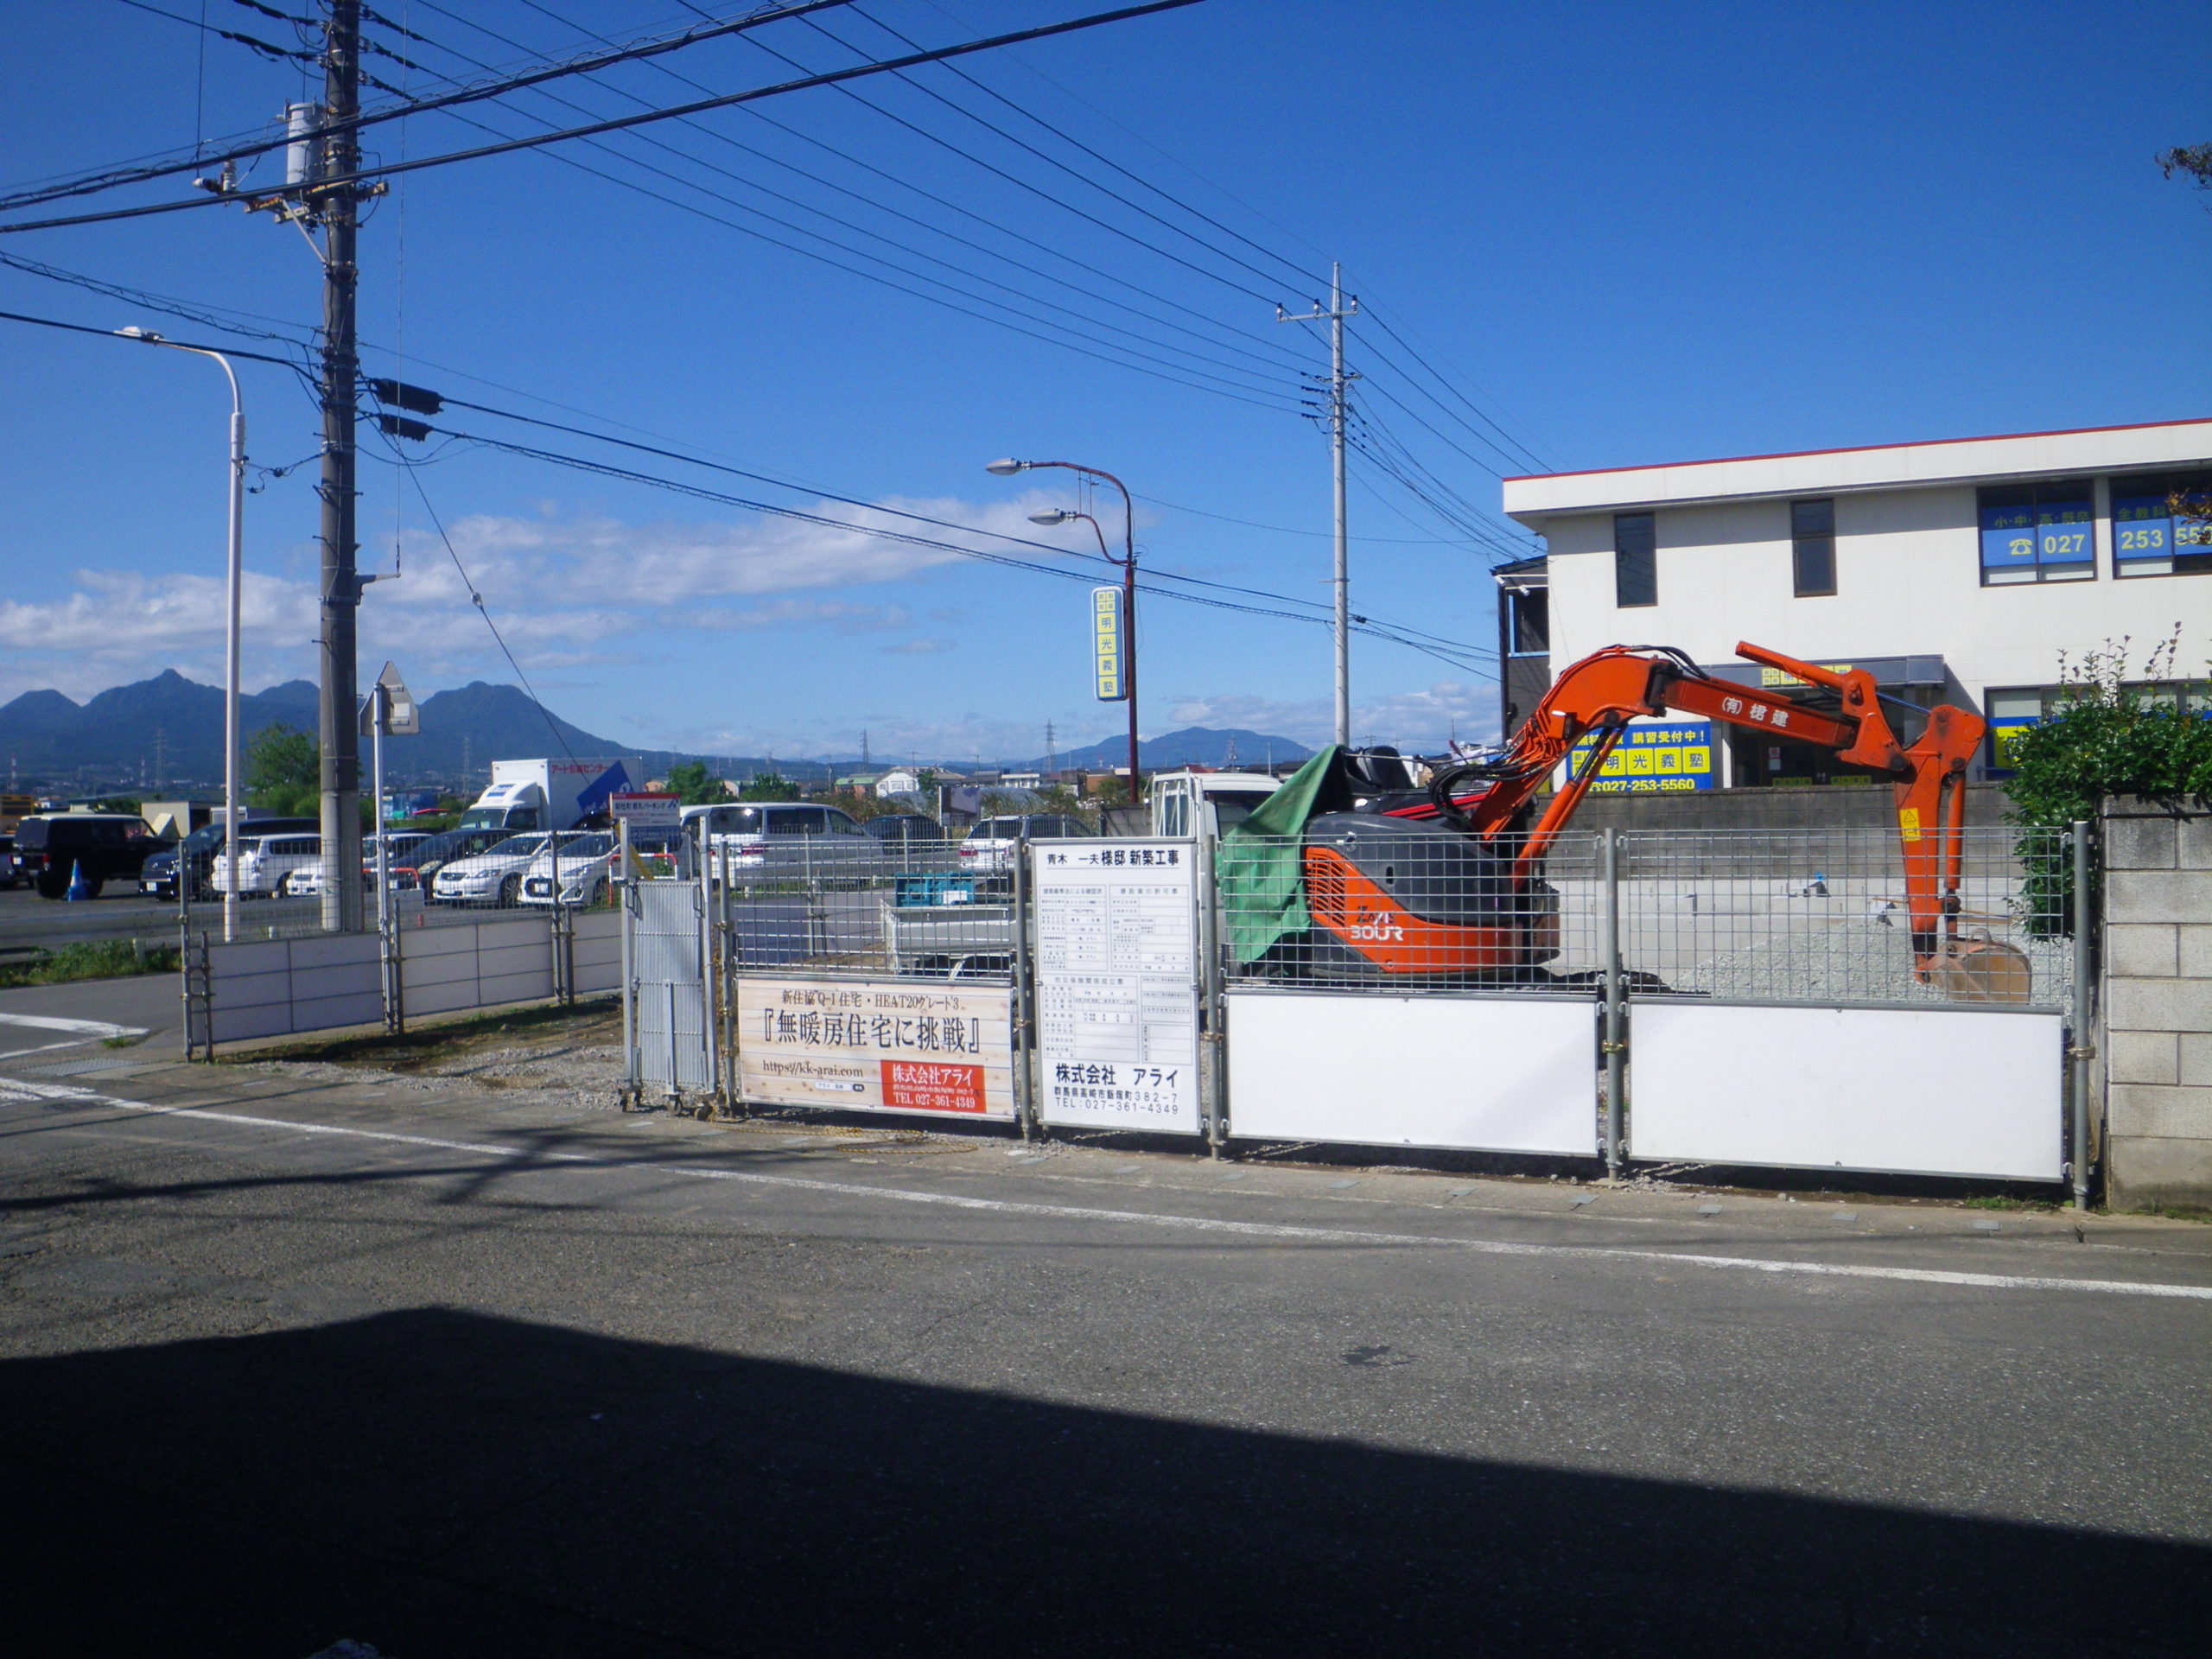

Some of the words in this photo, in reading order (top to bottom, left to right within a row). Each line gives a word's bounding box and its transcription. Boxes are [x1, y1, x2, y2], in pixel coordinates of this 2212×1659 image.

[2044, 534, 2085, 554] 027
[2121, 529, 2164, 550] 253
[1101, 616, 1114, 693] 明光義塾
[1606, 753, 1704, 772] 明光義塾
[1602, 779, 1696, 791] 027-253-5560
[1047, 854, 1068, 866] 青木
[1129, 849, 1179, 867] 新築工事
[762, 1059, 864, 1078] https://kk-arai.com
[893, 1064, 973, 1087] 株式会社アライ
[1055, 1063, 1116, 1086] 株式会社
[1133, 1068, 1179, 1089] アライ
[893, 1091, 913, 1104] TEL
[916, 1093, 976, 1109] 027-361-4349
